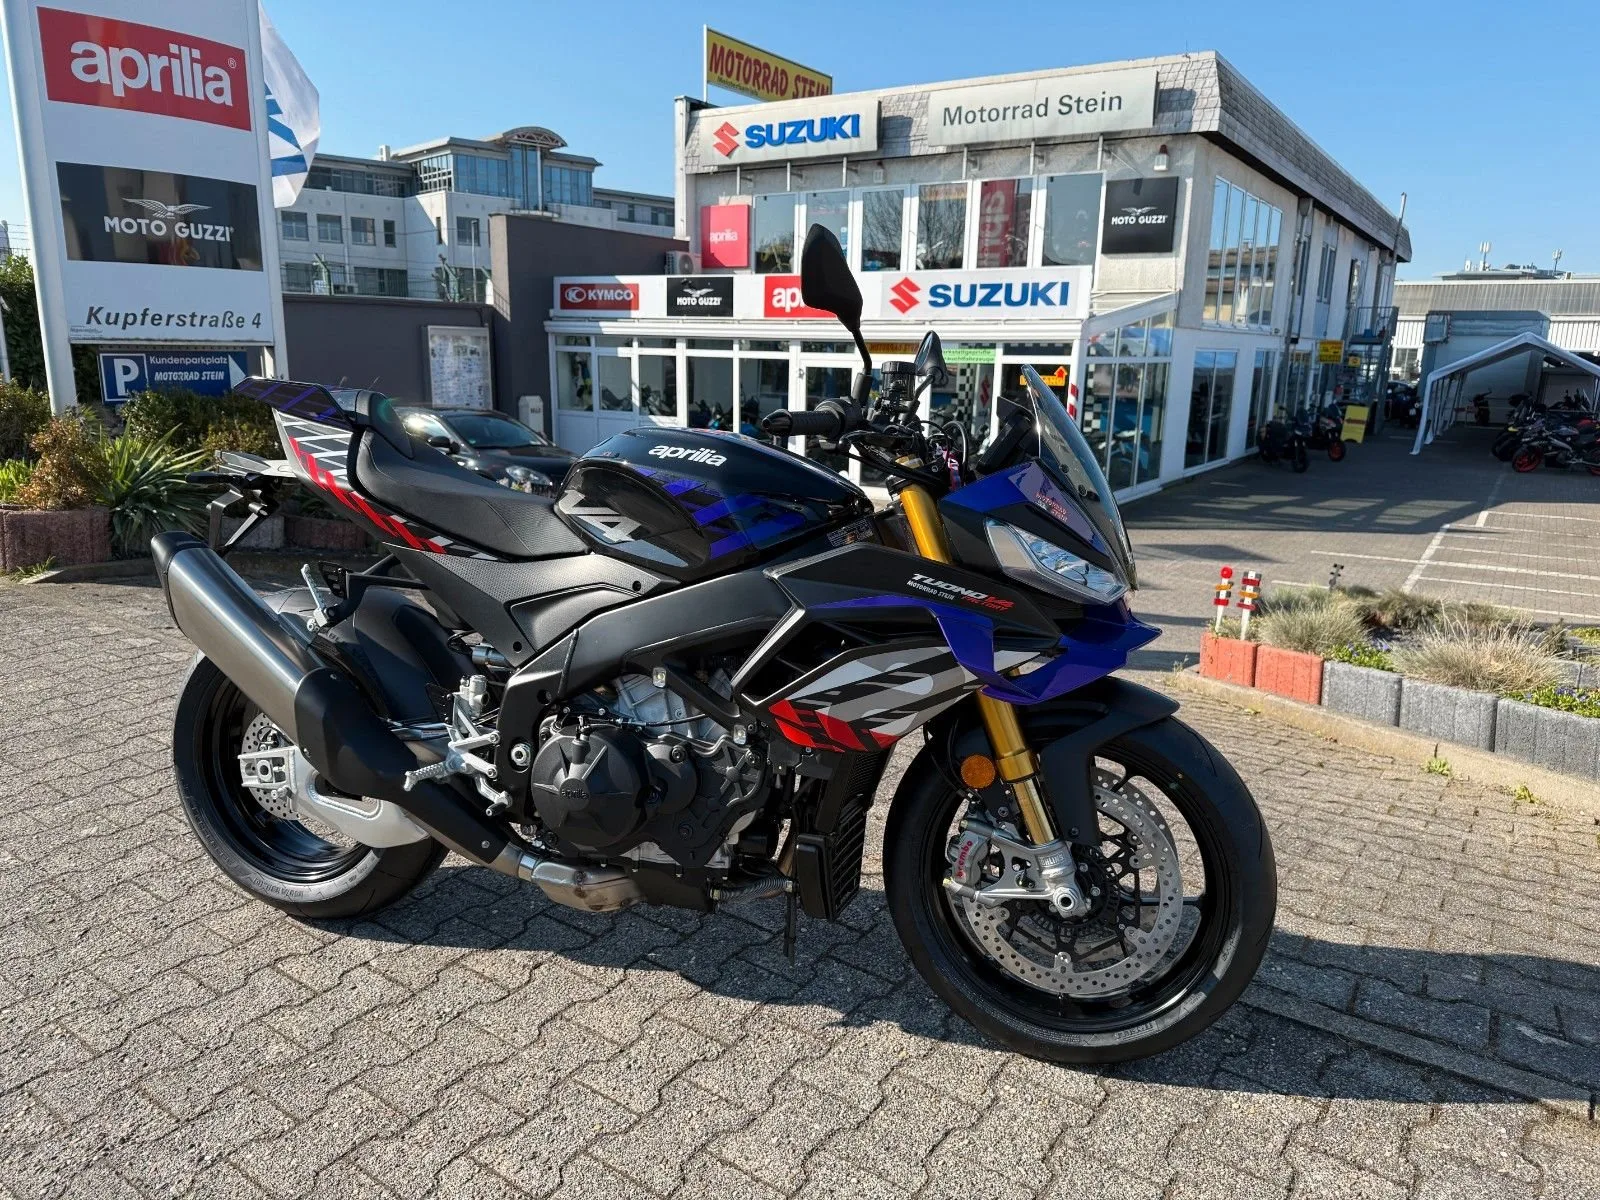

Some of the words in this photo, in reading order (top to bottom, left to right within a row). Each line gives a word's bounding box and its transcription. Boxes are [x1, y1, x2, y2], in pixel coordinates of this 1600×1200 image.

[70, 41, 233, 107] aprilia
[709, 42, 789, 97] MOTORRAD
[942, 97, 1049, 127] Motorrad
[1057, 91, 1123, 116] Stein
[745, 114, 861, 149] SUZUKI
[104, 216, 167, 236] MOTO
[174, 221, 231, 242] GUZZI
[1111, 216, 1136, 225] MOTO
[1138, 215, 1166, 224] GUZZI
[587, 289, 634, 301] KYMCO
[677, 297, 697, 306] MOTO
[698, 297, 721, 306] GUZZI
[928, 281, 1070, 308] SUZUKI
[86, 306, 246, 330] Kupferstraße
[251, 312, 261, 329] 4
[149, 356, 228, 366] Kundenparkplatz
[113, 358, 139, 396] P
[154, 371, 200, 381] MOTORRAD
[201, 371, 225, 380] STEIN
[648, 445, 727, 467] aprilia
[907, 580, 937, 595] MOTORRAD
[938, 591, 955, 601] STEIN
[912, 573, 988, 600] TUONO
[956, 840, 973, 879] brembo
